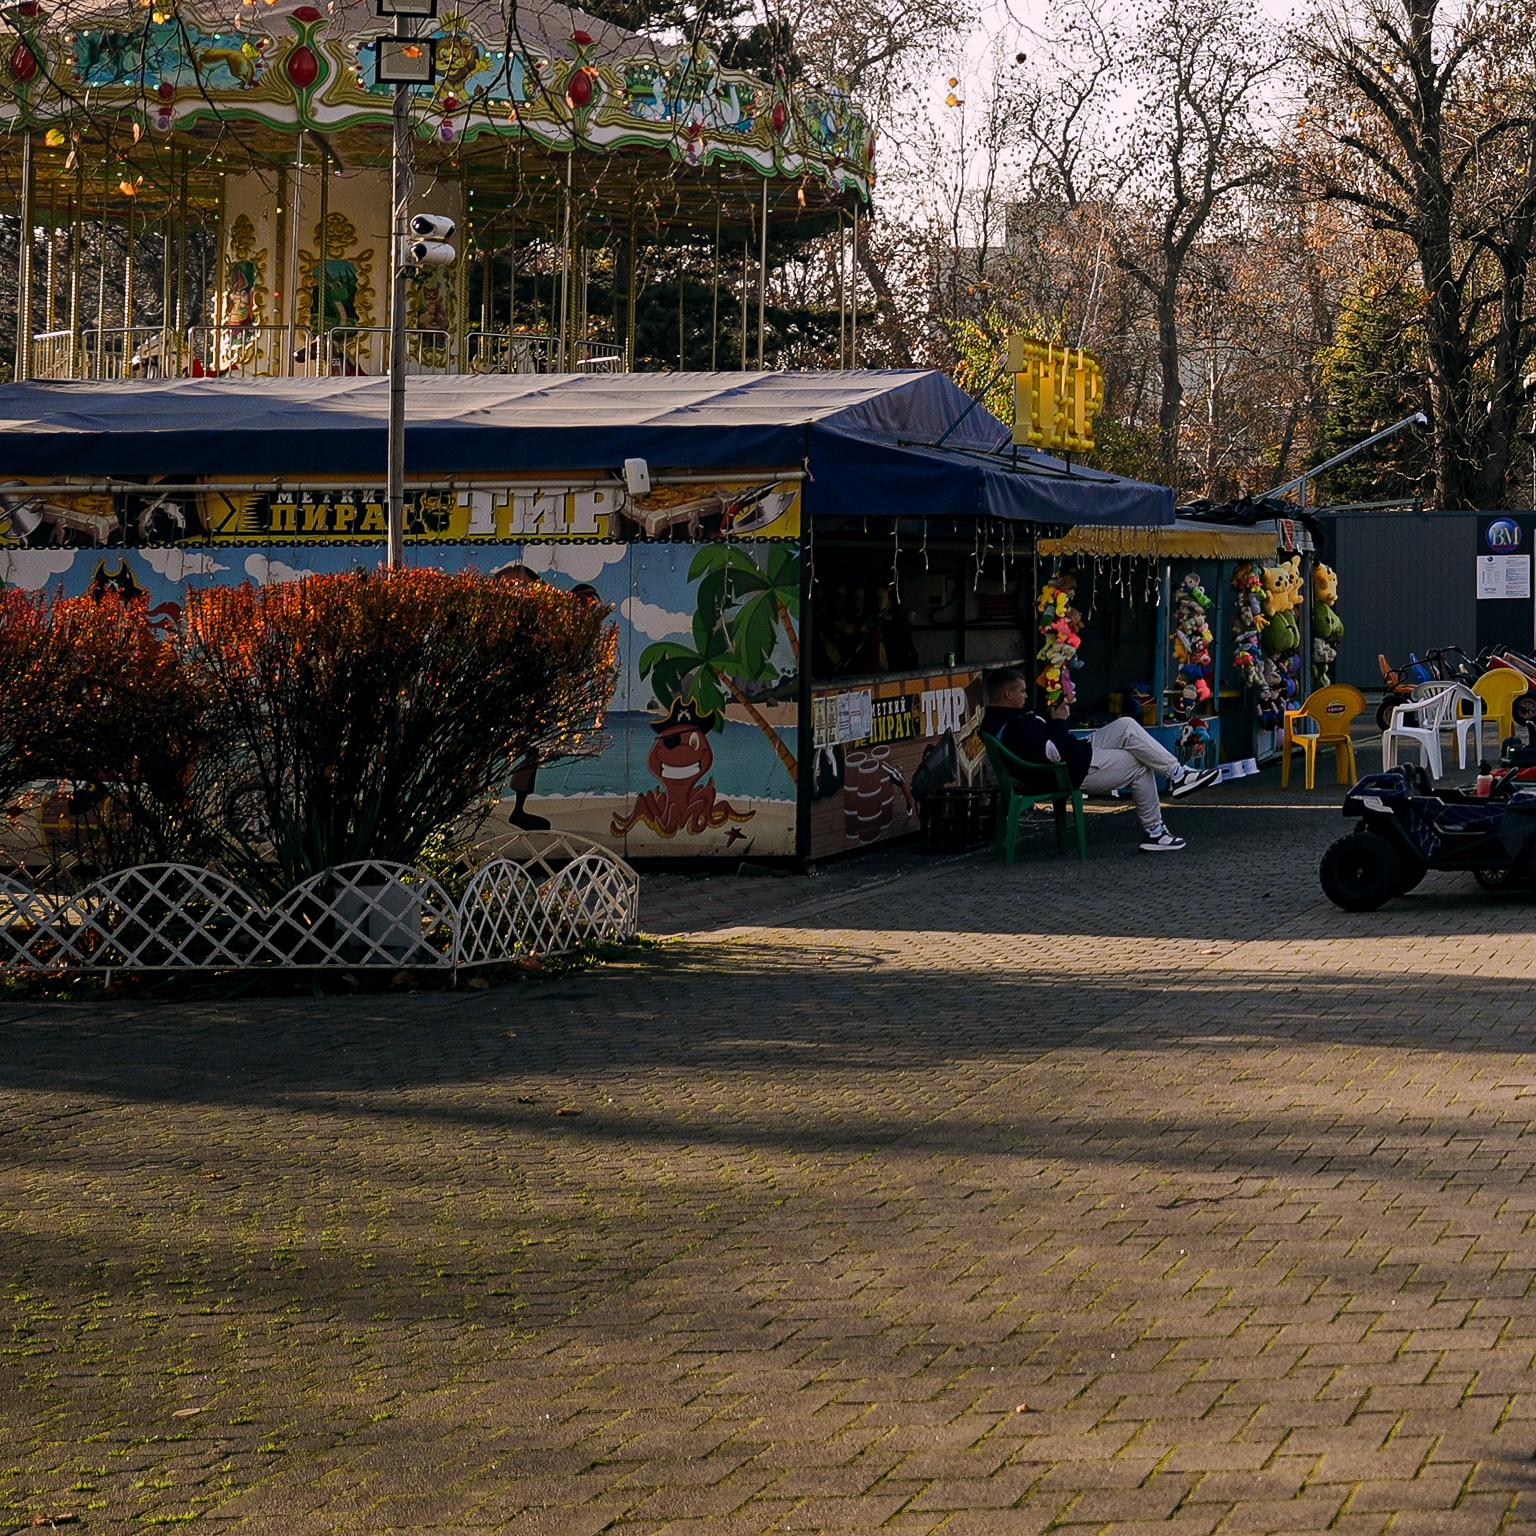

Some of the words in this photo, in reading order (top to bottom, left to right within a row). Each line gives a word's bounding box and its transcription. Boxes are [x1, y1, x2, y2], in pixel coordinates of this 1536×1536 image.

[270, 504, 416, 531] ПИРАТ
[456, 486, 625, 534] ТИР
[922, 687, 966, 737] ТИР
